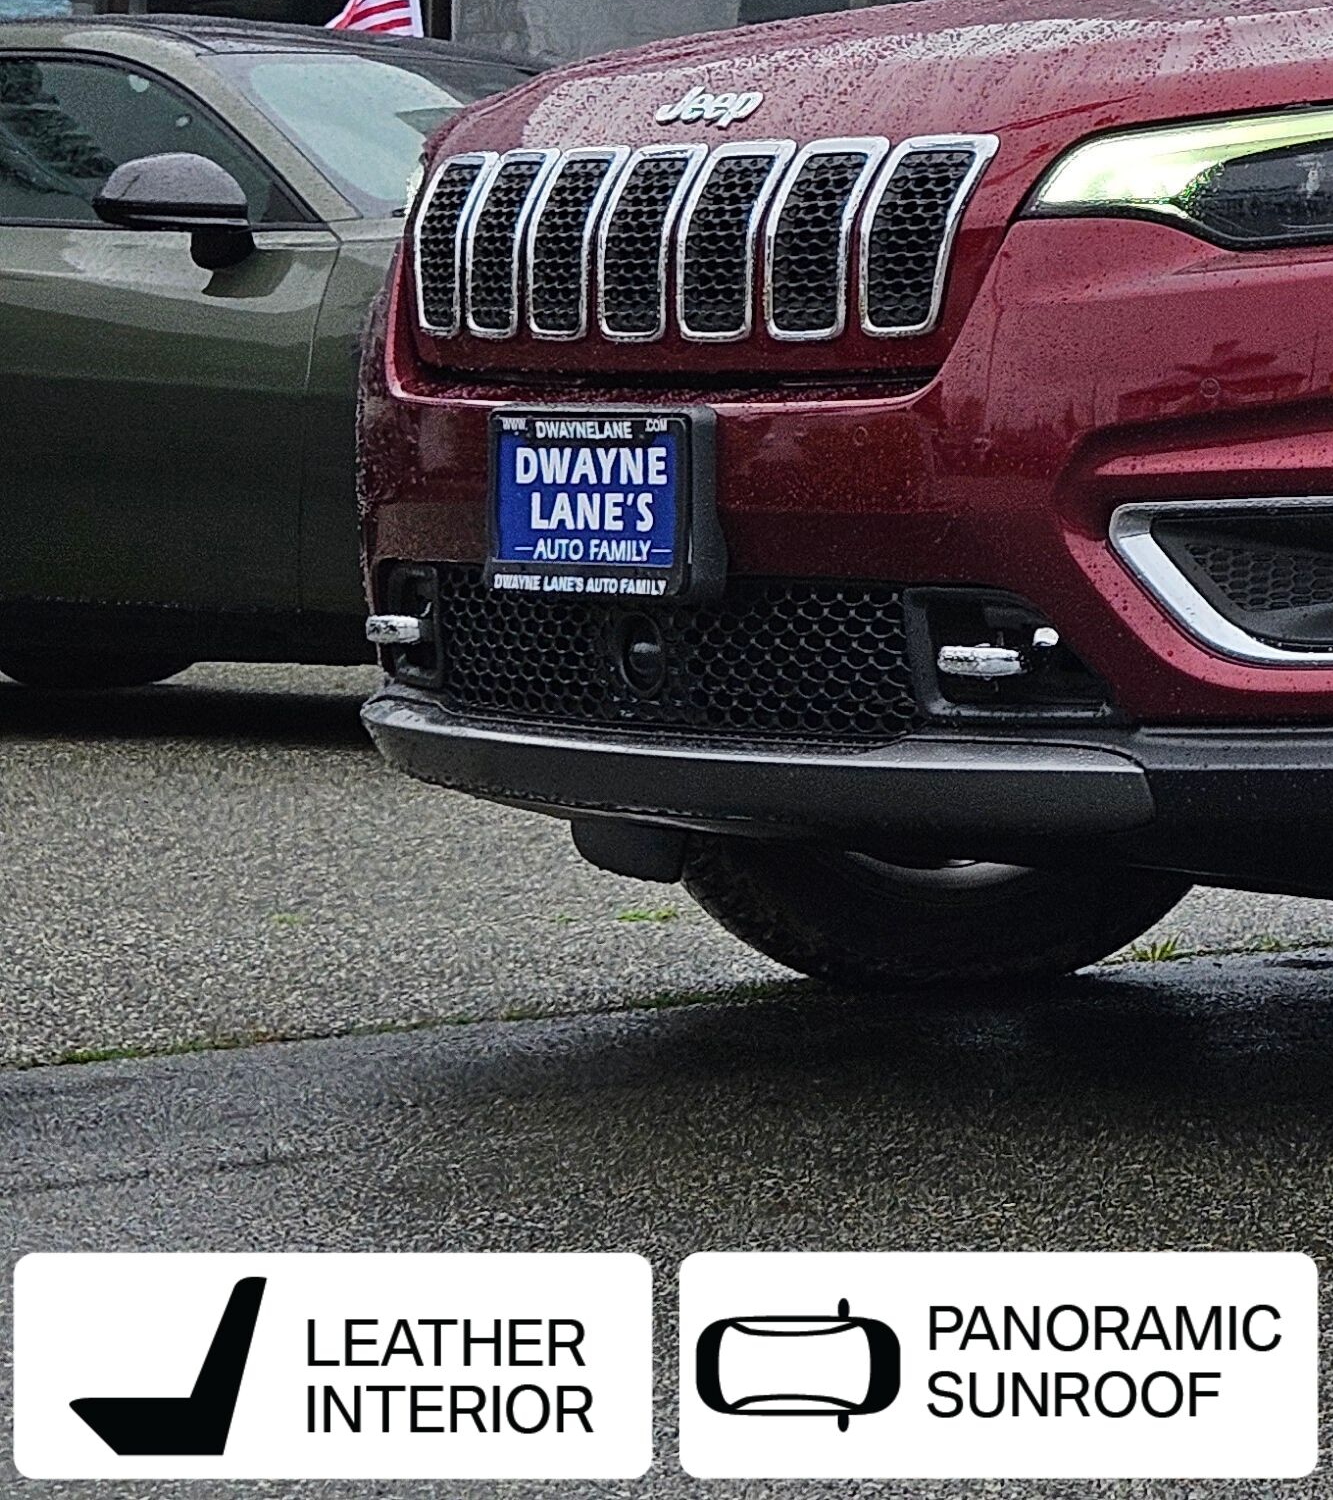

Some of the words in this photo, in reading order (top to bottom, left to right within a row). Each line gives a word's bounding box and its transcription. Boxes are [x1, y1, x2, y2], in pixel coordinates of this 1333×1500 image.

[655, 85, 764, 129] Jeep
[535, 421, 632, 440] DWAYNELANE
[515, 447, 668, 485] DWAYNE
[530, 491, 654, 532] LANE'S
[533, 538, 584, 560] AUTO
[589, 539, 652, 562] FAMILY
[494, 573, 541, 591] DWAYNE
[543, 574, 584, 592] LANE'S
[586, 577, 618, 593] AUTO
[619, 578, 667, 595] FAMILY
